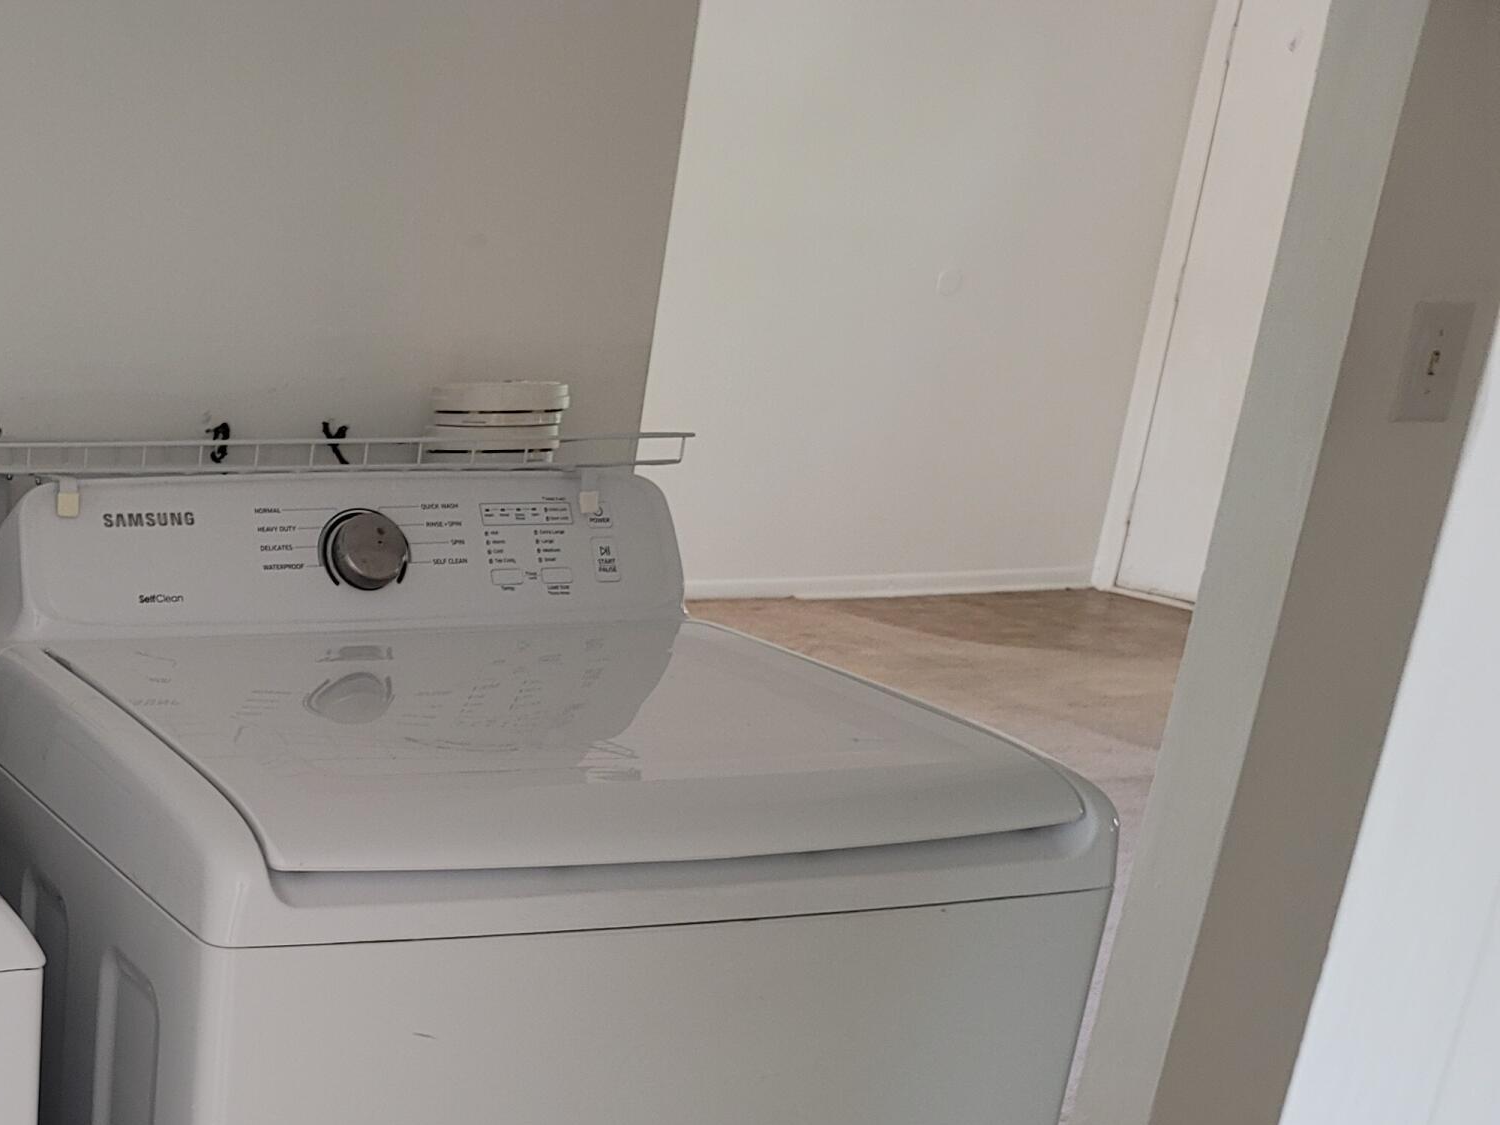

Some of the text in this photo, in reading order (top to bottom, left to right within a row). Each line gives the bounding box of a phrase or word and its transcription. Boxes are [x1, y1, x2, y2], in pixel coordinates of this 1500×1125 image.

[103, 511, 195, 528] SAMSUNG
[257, 525, 277, 533] HEAVY
[260, 544, 293, 552] DELICATES
[432, 558, 447, 566] SELF
[597, 557, 616, 565] START
[262, 562, 304, 571] WATERPROOF
[598, 565, 617, 573] PAUSE
[139, 593, 184, 604] SelfClean
